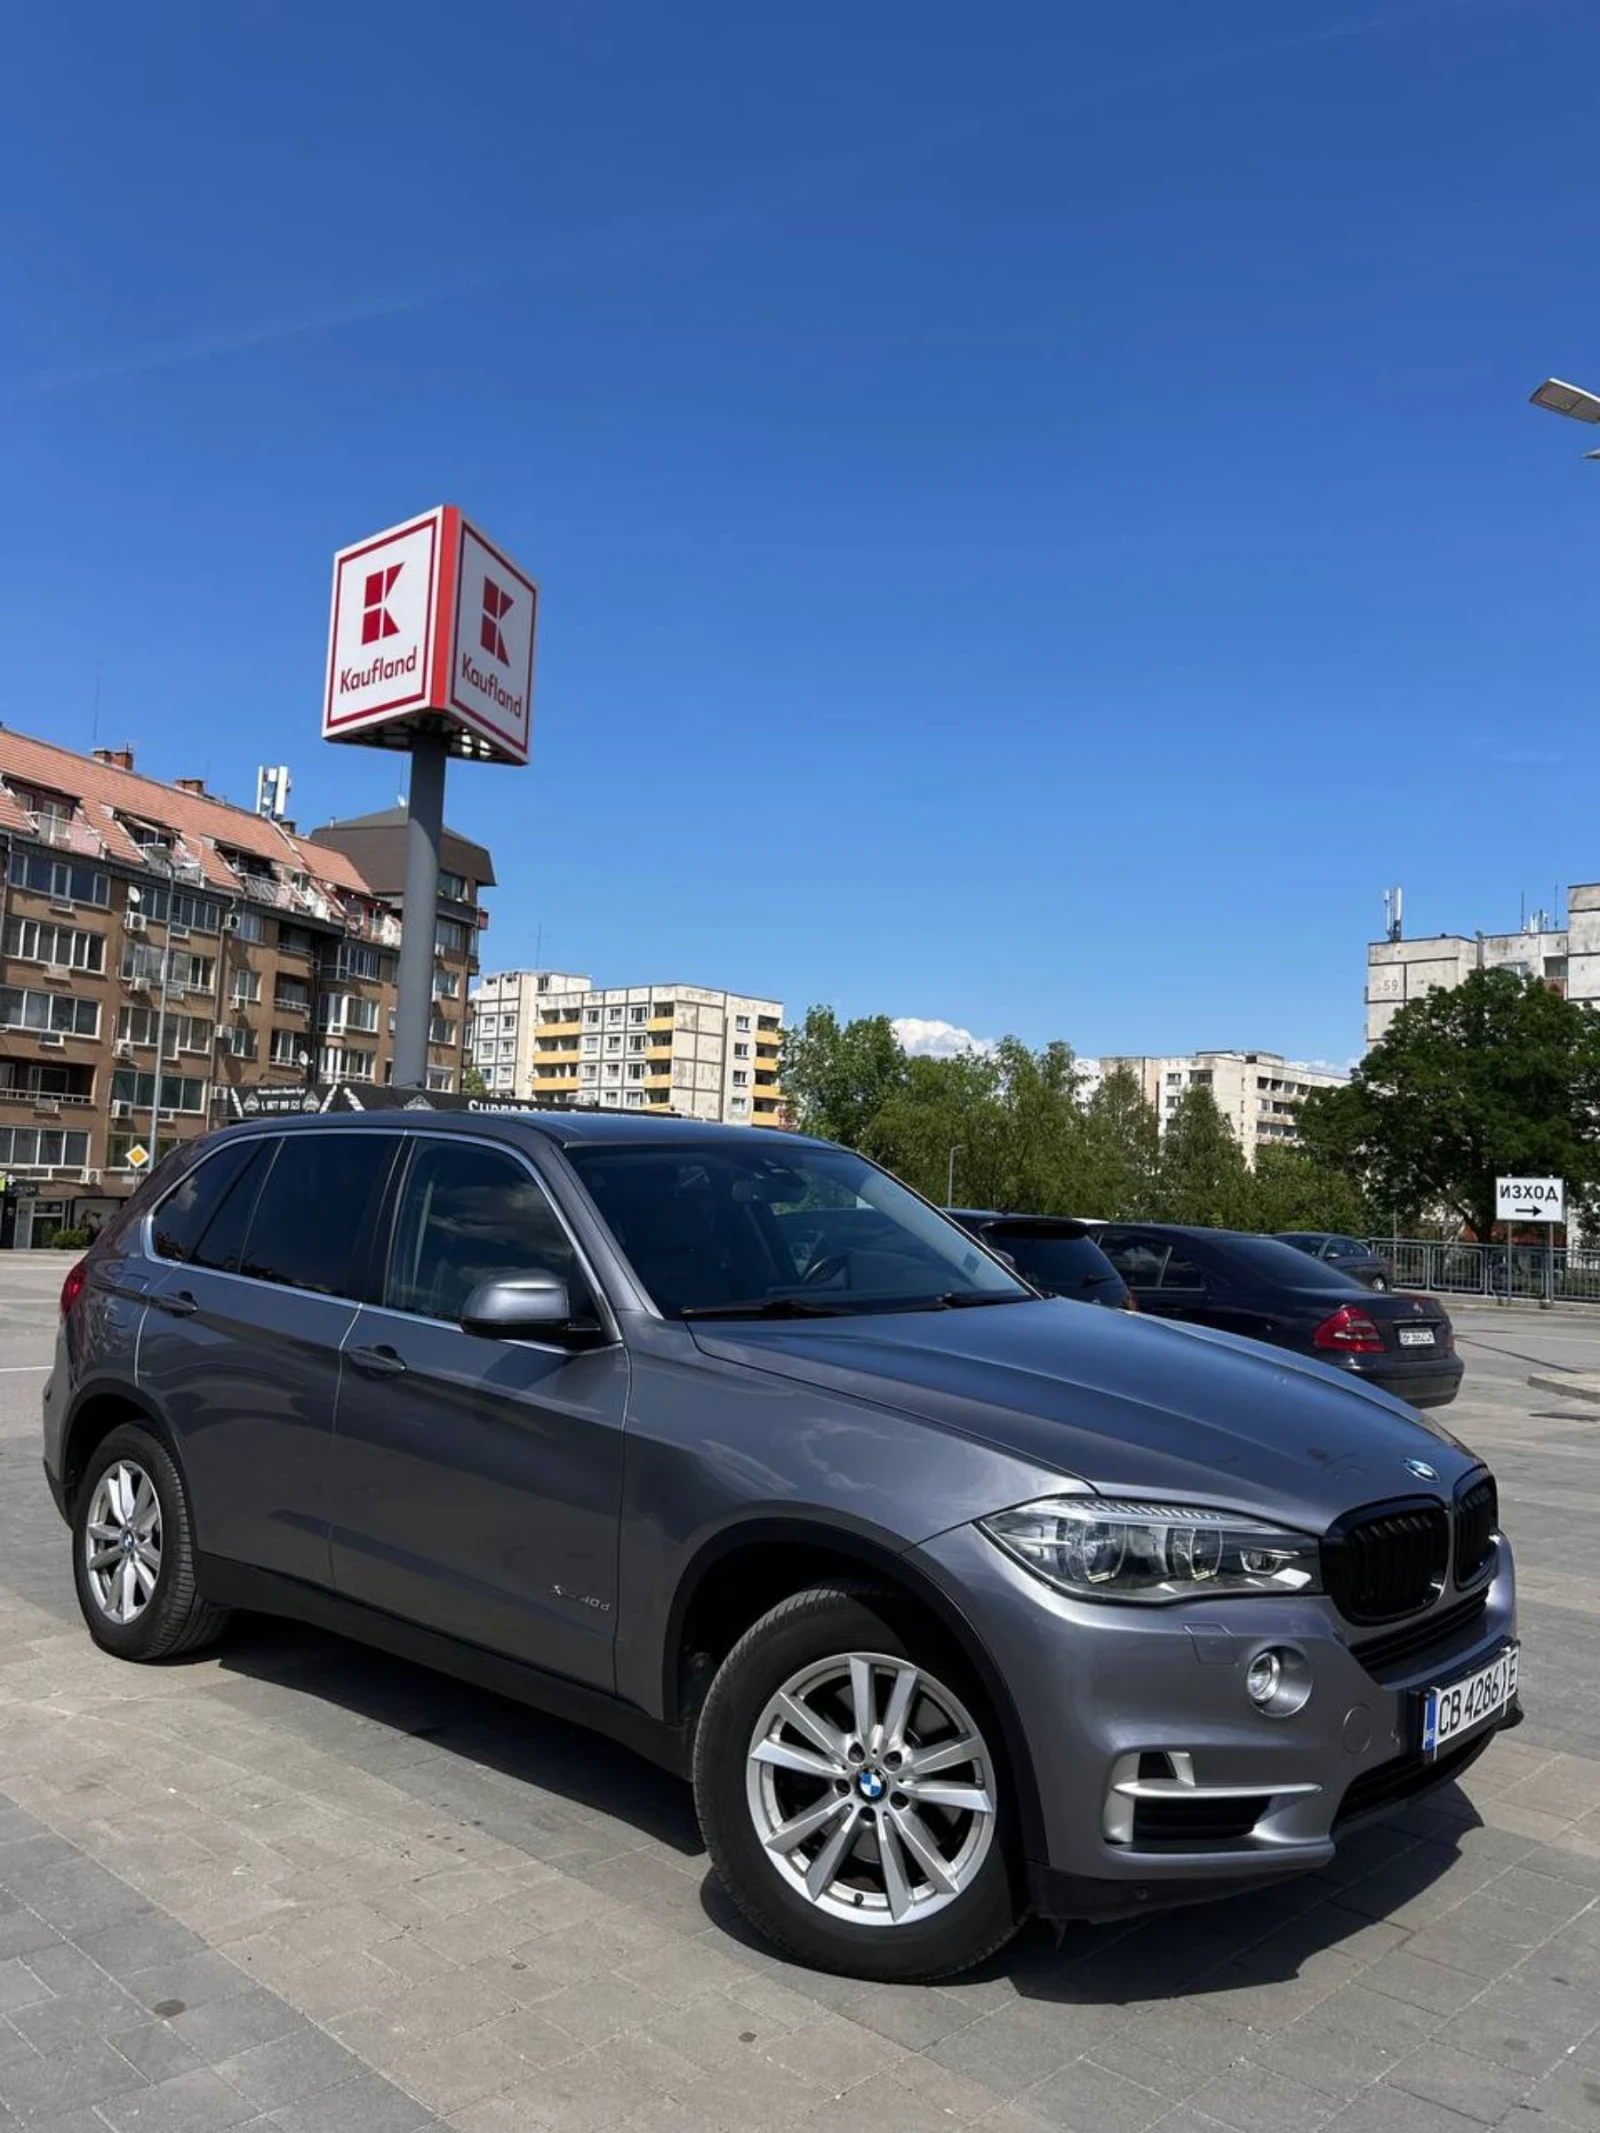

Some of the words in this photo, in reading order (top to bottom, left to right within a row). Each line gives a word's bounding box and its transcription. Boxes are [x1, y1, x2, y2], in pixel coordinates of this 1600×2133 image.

[340, 646, 417, 694] Kaufland
[462, 653, 522, 718] Kaufland
[1383, 979, 1399, 992] 59
[1500, 1185, 1559, 1202] ИЗХОД
[1439, 1689, 1461, 1737] CB
[1464, 1666, 1500, 1721] 4286
